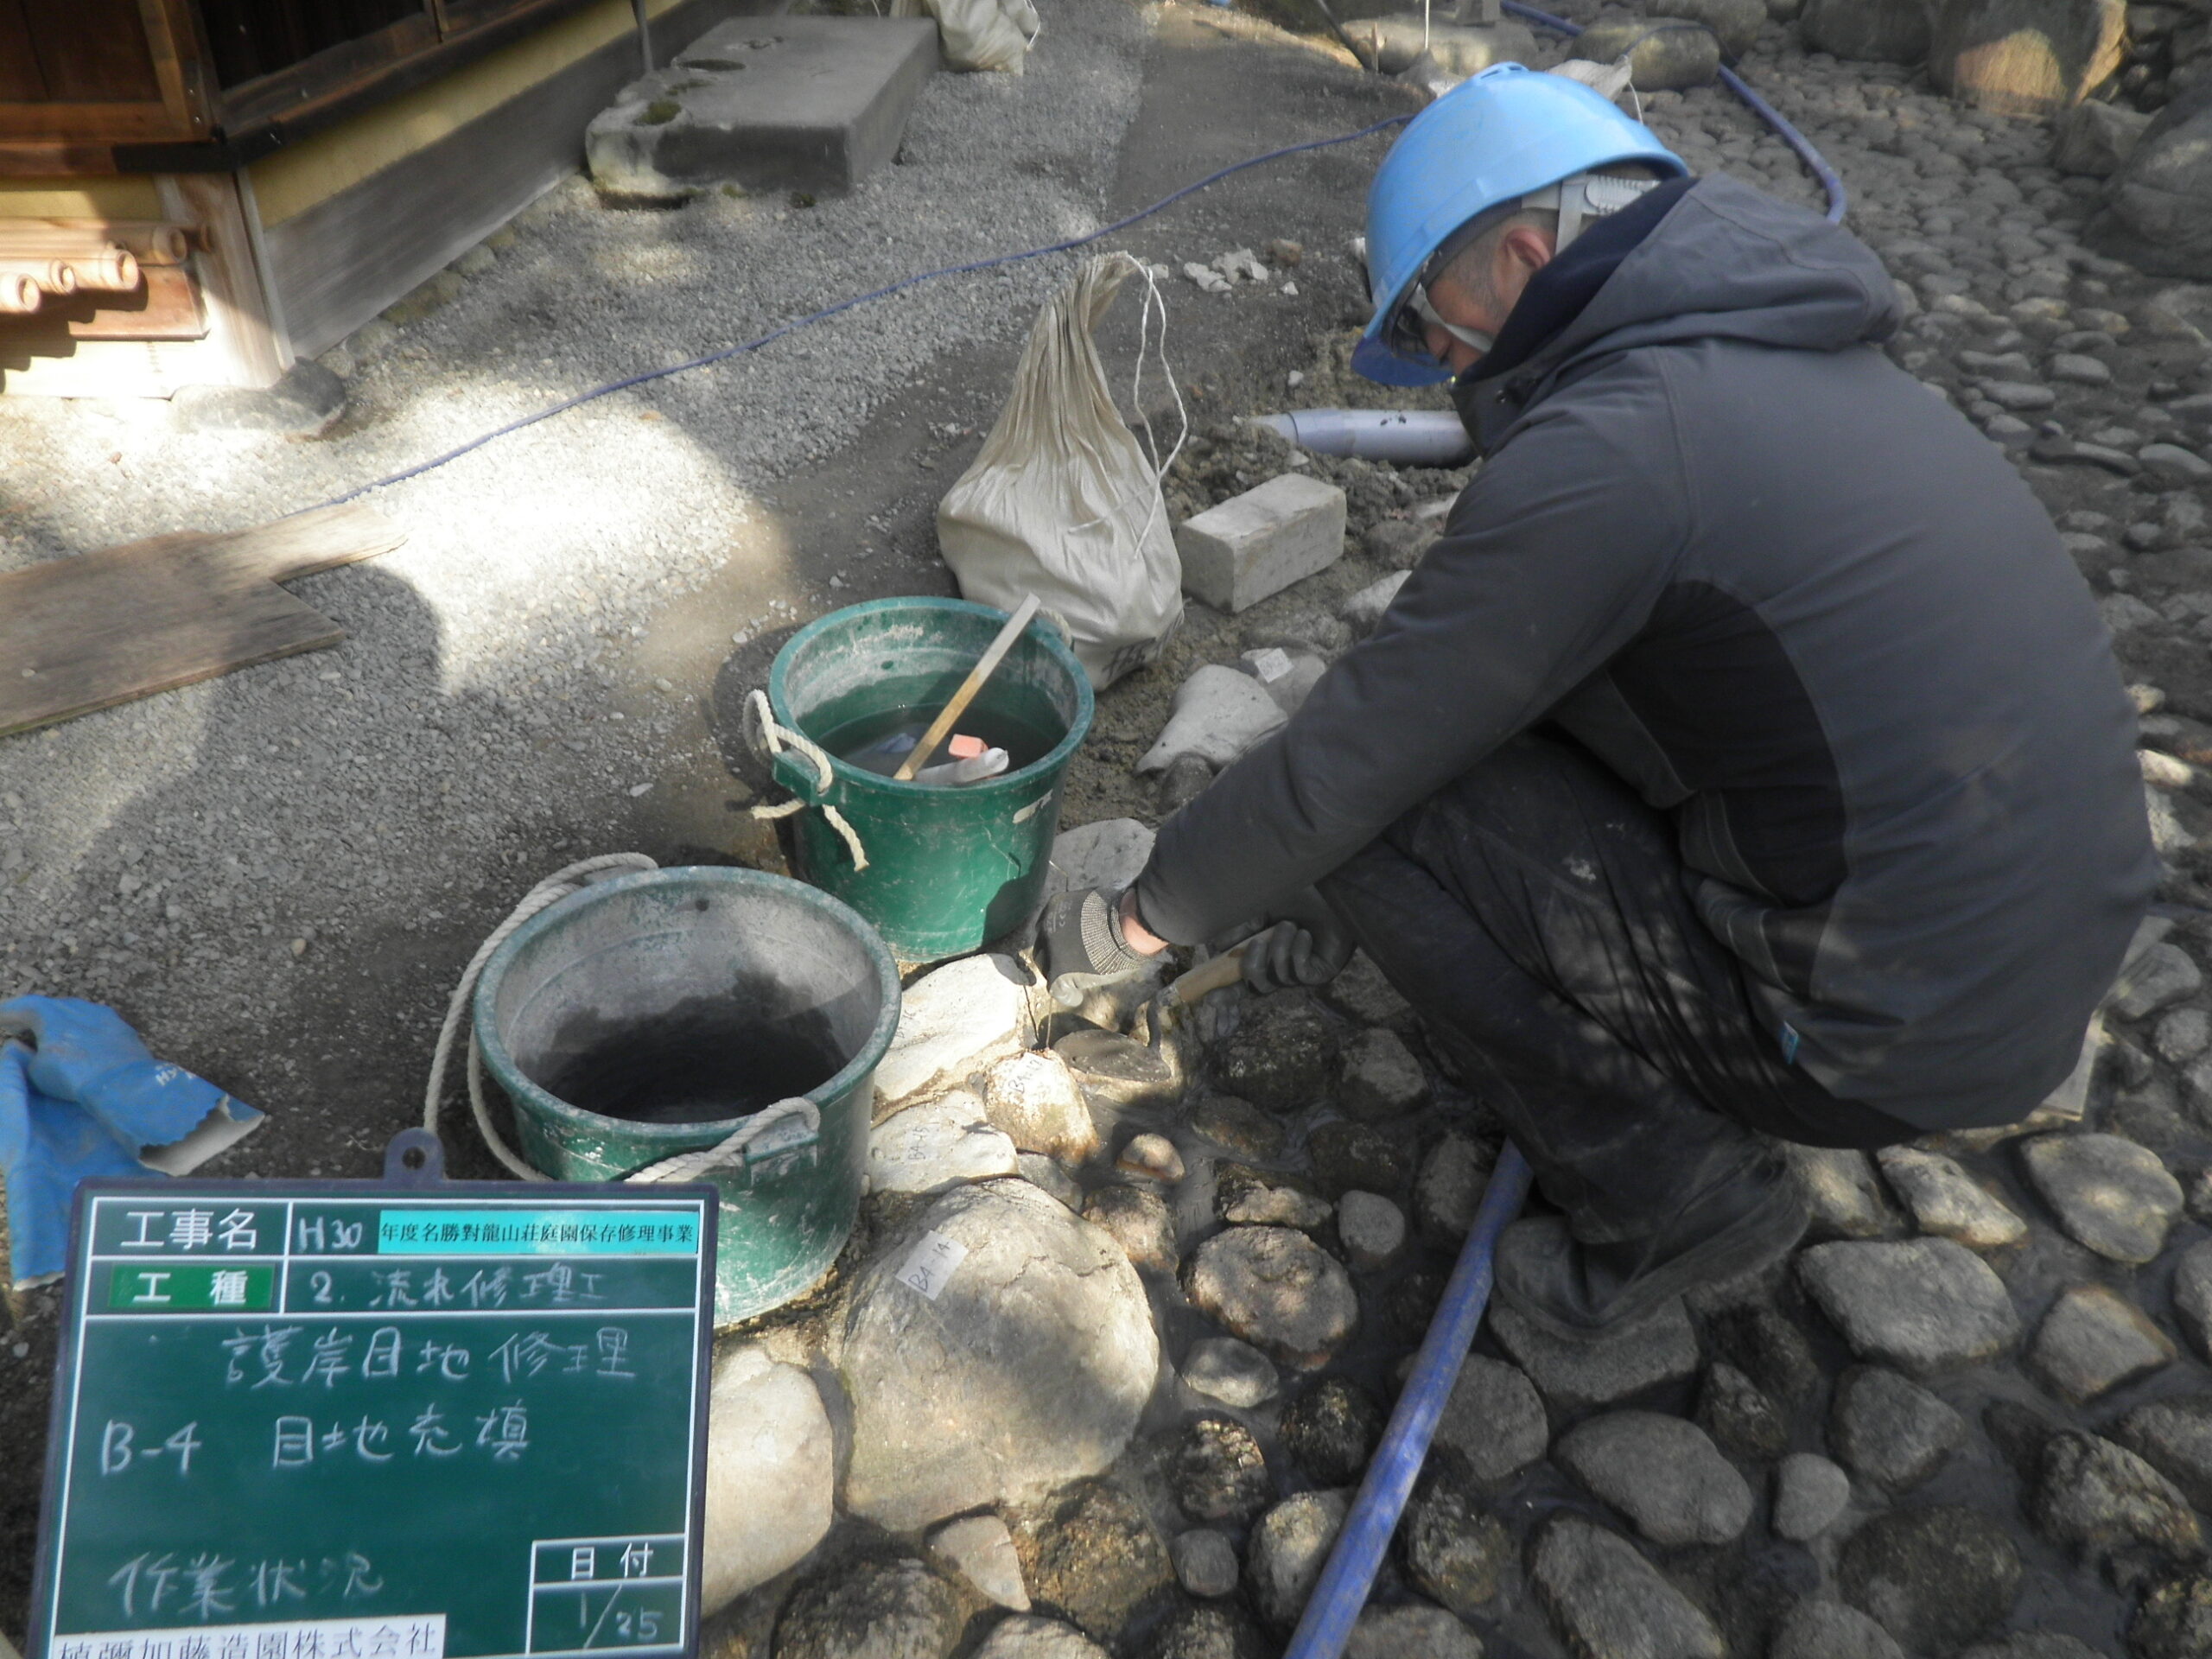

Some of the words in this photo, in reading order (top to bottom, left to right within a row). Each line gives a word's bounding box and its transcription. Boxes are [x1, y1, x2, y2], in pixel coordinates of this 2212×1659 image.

[121, 1207, 258, 1250] 工事名
[299, 1216, 364, 1252] H30
[907, 1241, 951, 1294] B4-14
[221, 1324, 638, 1389] 護岸目地修理
[99, 1419, 203, 1476] B-4
[107, 1552, 385, 1618] 作業状況
[570, 1541, 654, 1579] 日付
